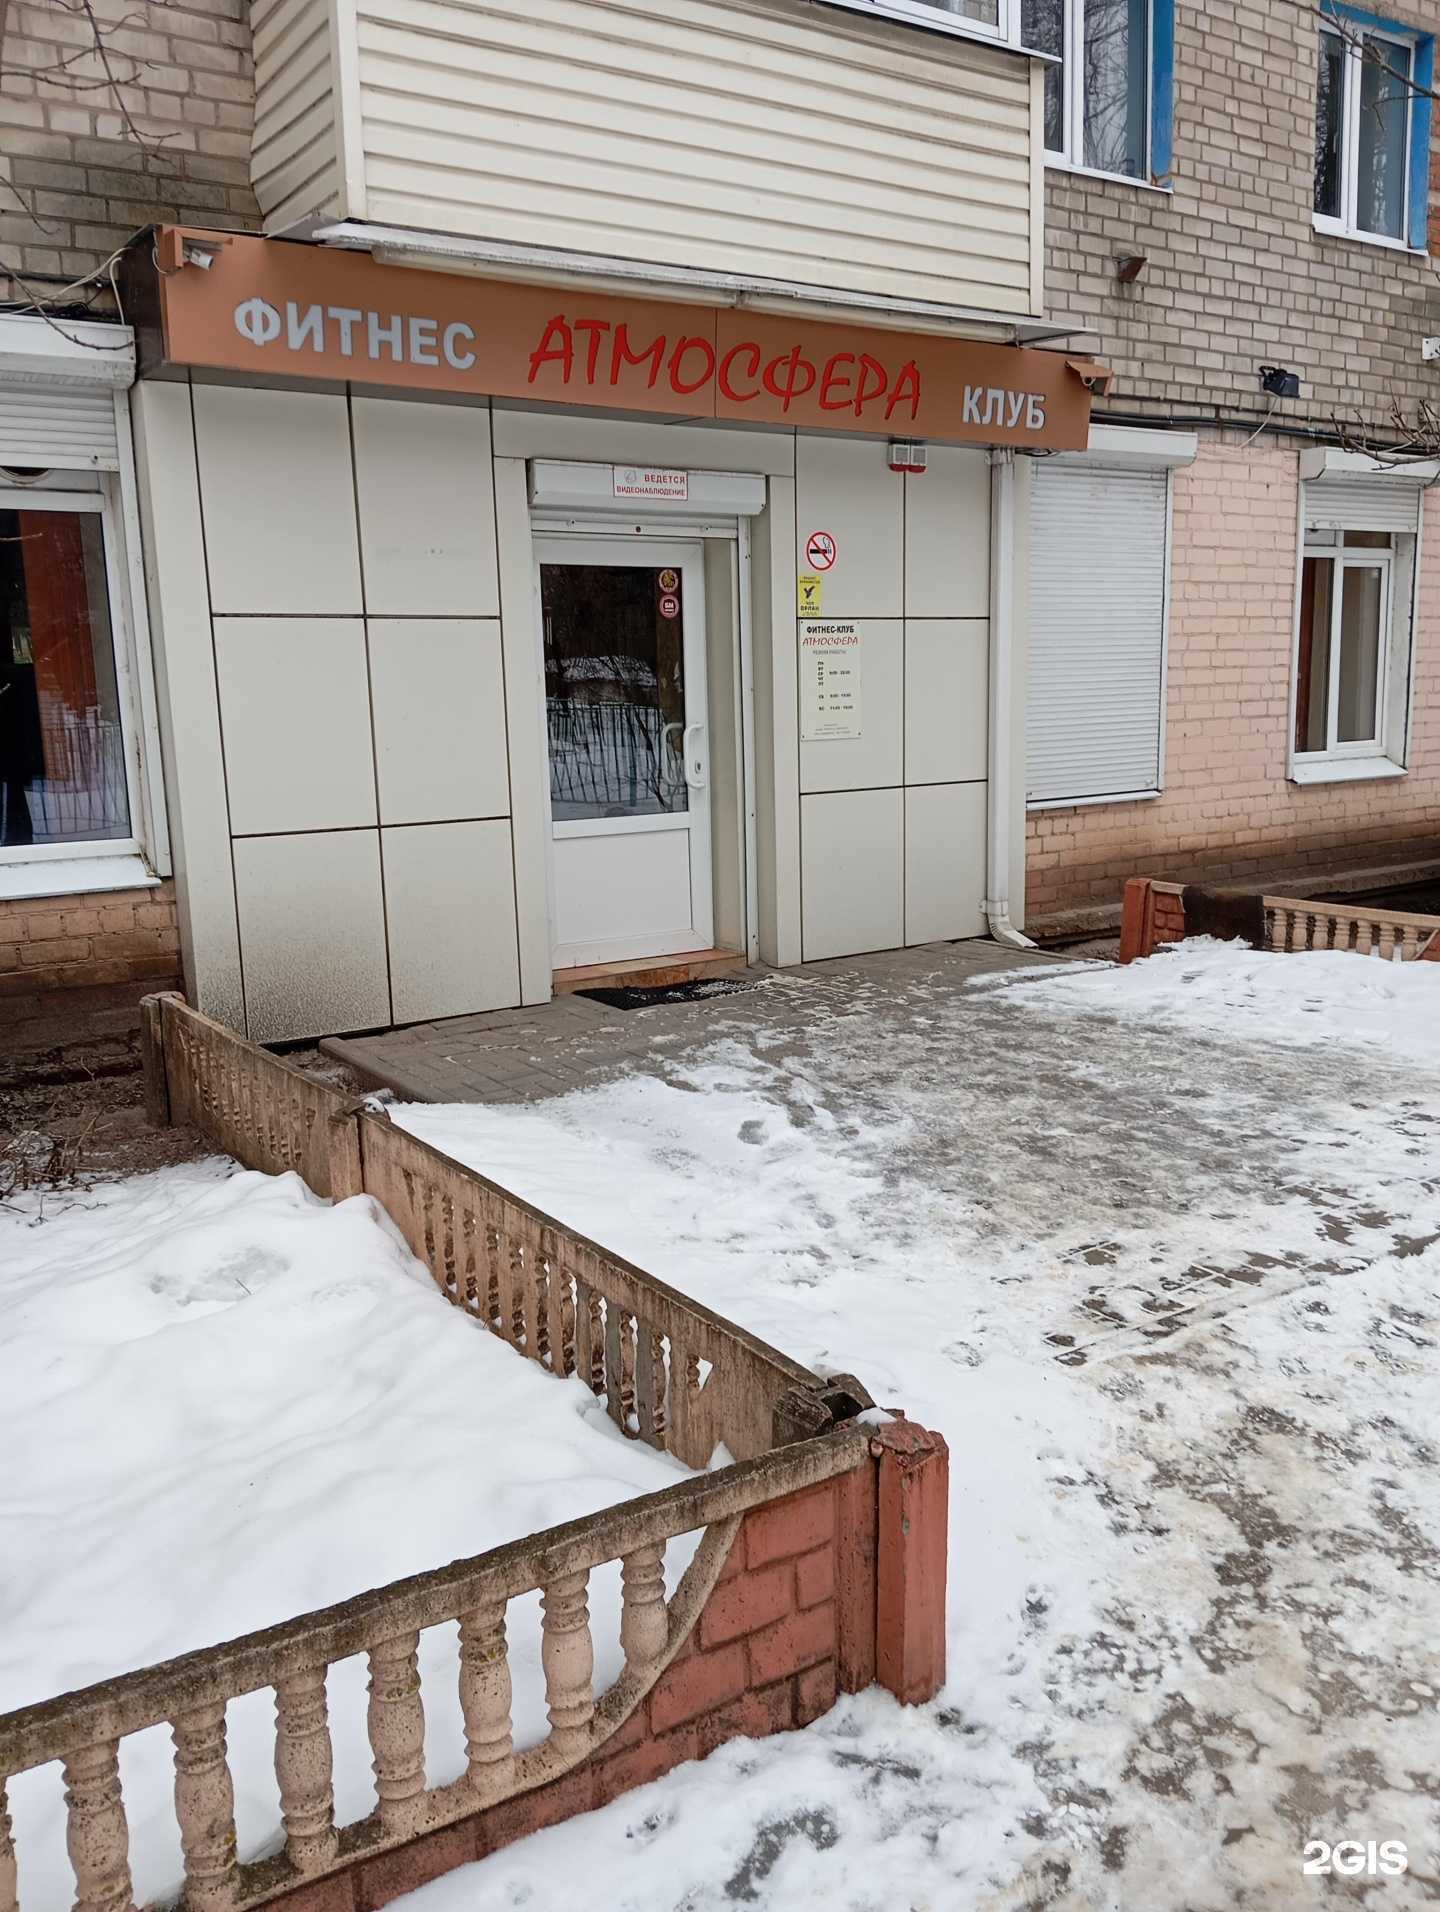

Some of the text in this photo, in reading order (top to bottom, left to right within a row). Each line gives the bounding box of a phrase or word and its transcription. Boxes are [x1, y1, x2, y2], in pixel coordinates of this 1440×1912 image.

[233, 297, 1046, 430] ФИТНЕС АТМОСФЕРА КЛУБ
[644, 474, 685, 484] ВЕДЕТСЯ
[616, 485, 685, 496] ВИДЕОНАБЛЮДЕНИЕ
[806, 625, 855, 634] ФИТНЕС-КЛУБ
[802, 636, 858, 646] АТМОСФЕРА
